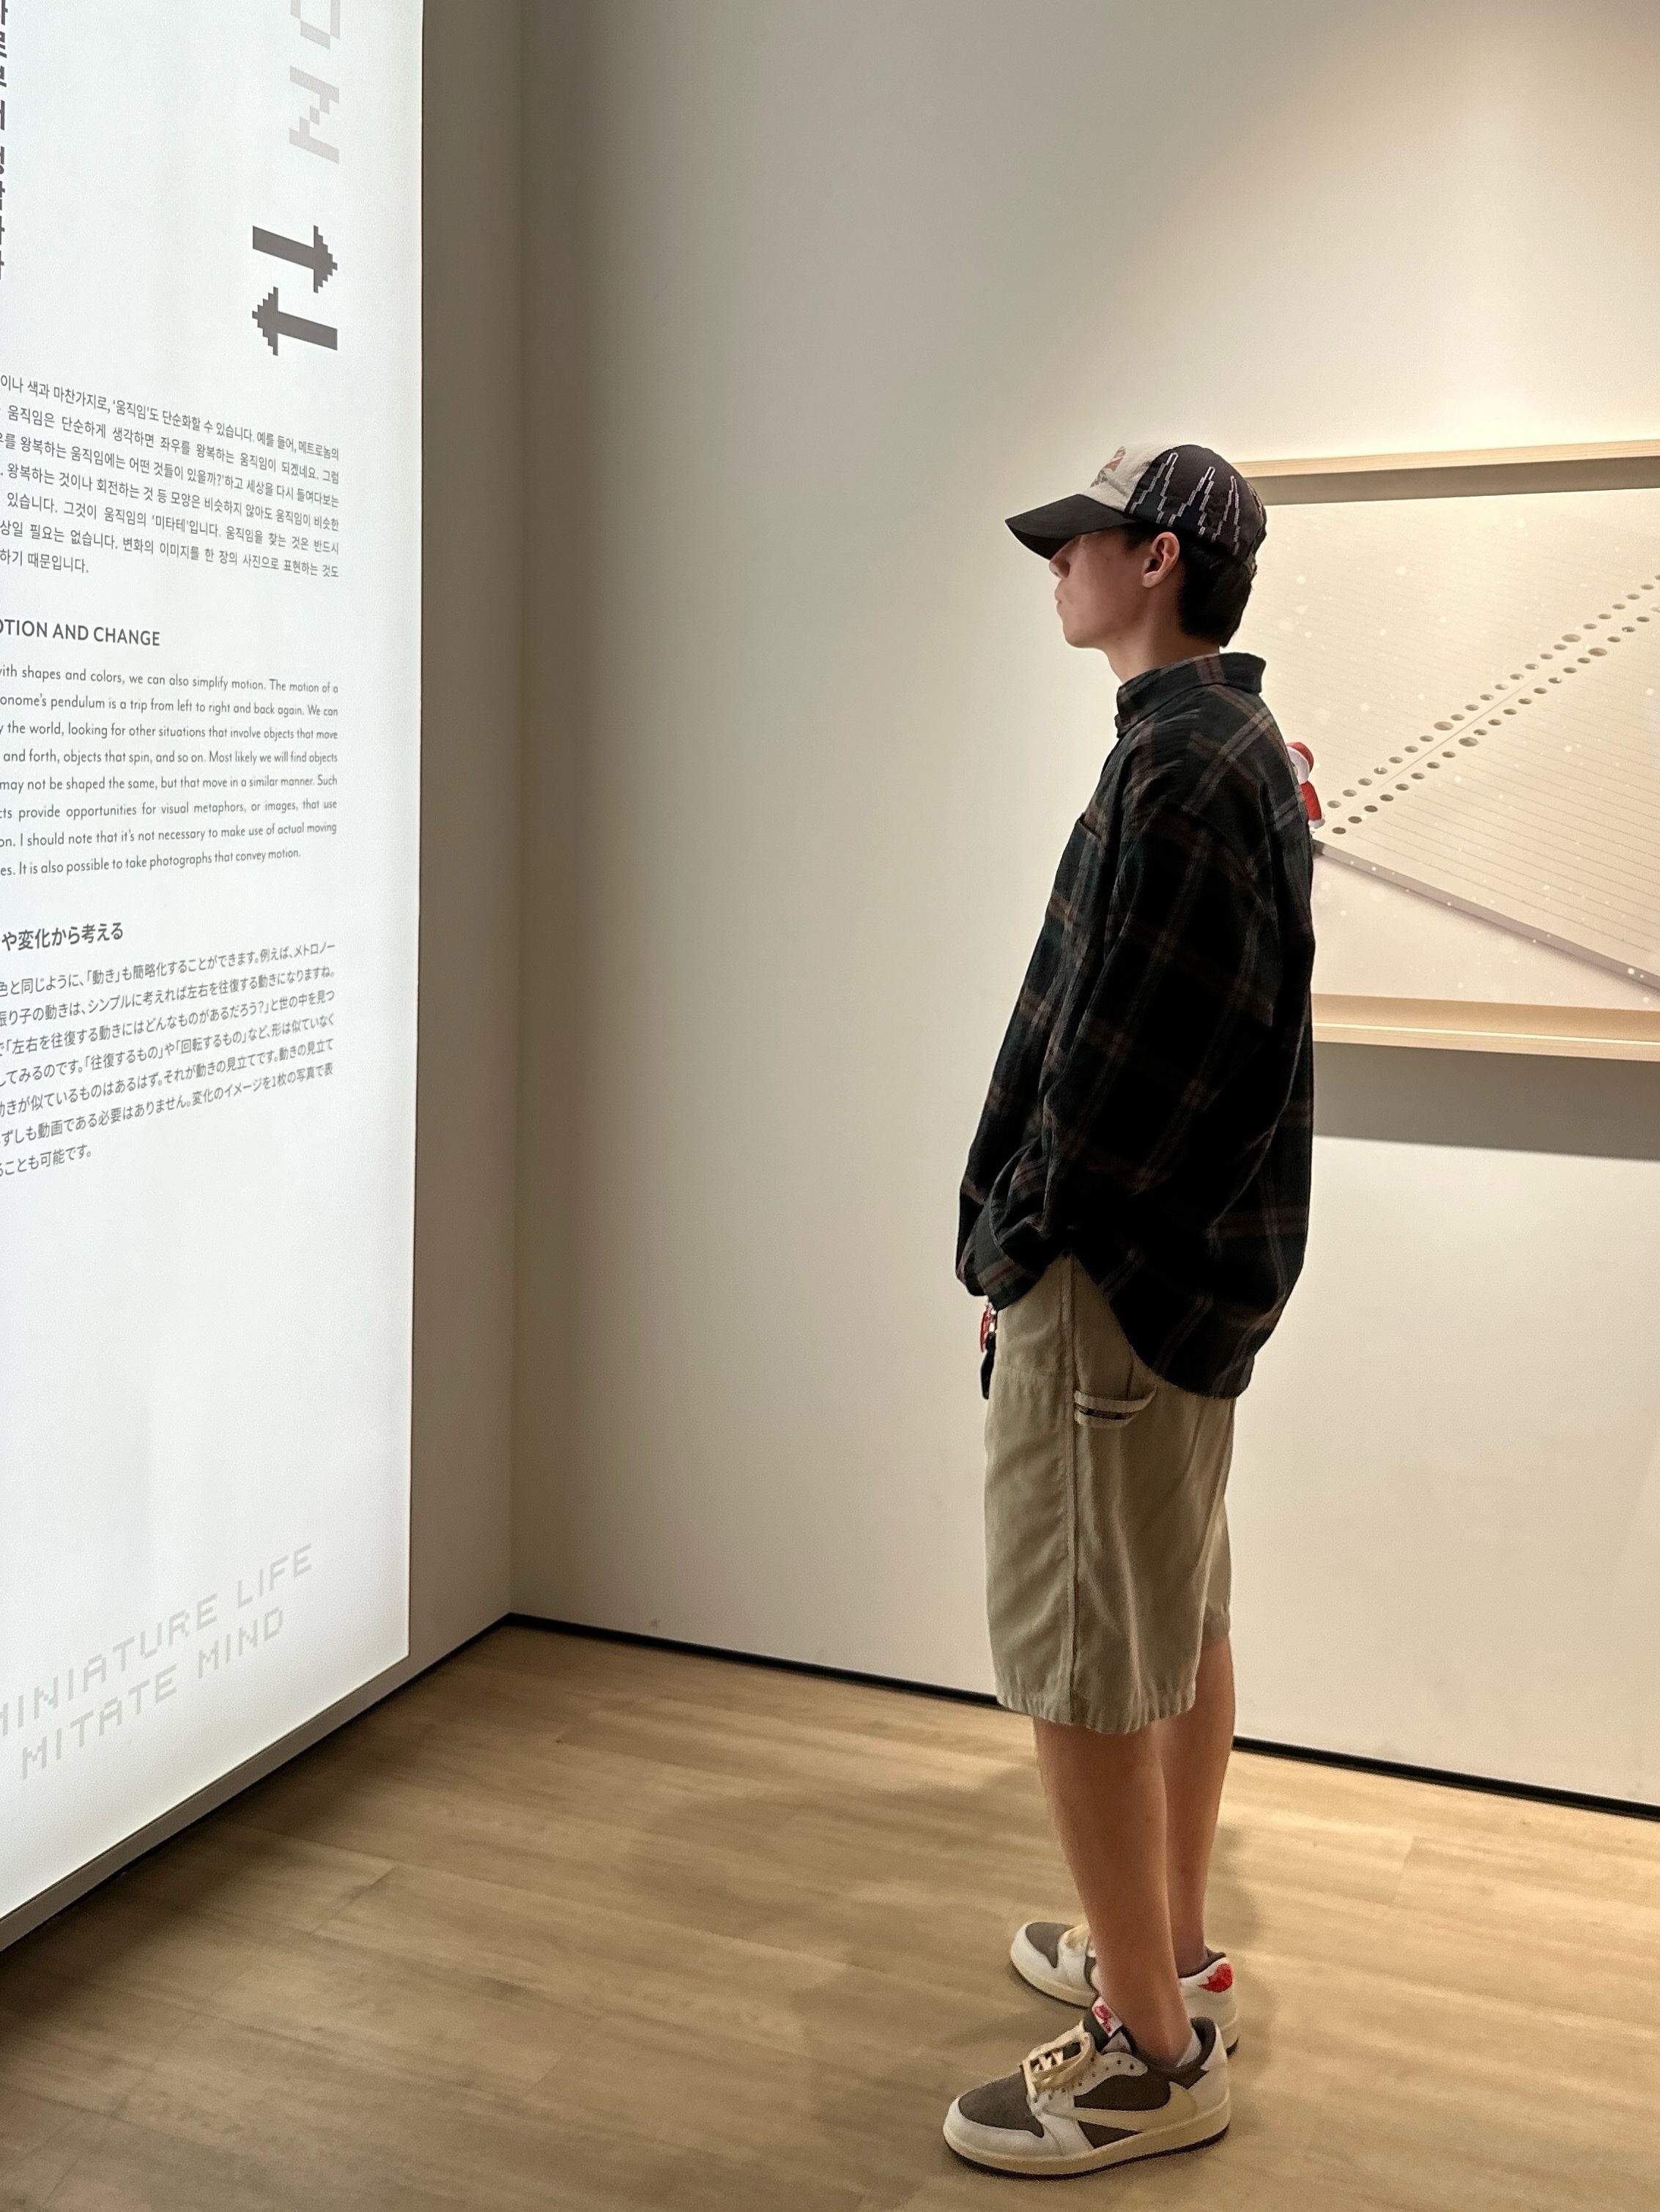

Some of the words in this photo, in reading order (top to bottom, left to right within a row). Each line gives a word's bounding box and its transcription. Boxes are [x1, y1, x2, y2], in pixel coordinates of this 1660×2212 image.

[1, 375, 23, 393] 이나
[27, 381, 50, 398] 색과
[53, 387, 110, 414] 마찬가지로,
[163, 410, 201, 431] 단순화할
[204, 420, 213, 433] 수
[216, 423, 254, 442] 있습니다.
[257, 432, 274, 447] 예를
[278, 436, 296, 453] 들어,
[299, 441, 338, 461] 메트로놈의
[8, 405, 55, 428] 움직임은
[62, 417, 105, 439] 단순하게
[113, 427, 154, 448] 생각하면
[160, 437, 190, 456] 좌우를
[196, 444, 234, 464] 왕복하는
[240, 453, 275, 472] 움직임이
[282, 461, 319, 480] 되겠네요.
[323, 470, 338, 484] 그럼
[21, 437, 67, 459] 왕복하는
[71, 446, 125, 470] 움직임에는
[130, 458, 149, 474] 어떤
[154, 462, 183, 480] 것들이
[247, 480, 273, 496] 세상을
[277, 485, 293, 500] 다시
[297, 489, 338, 508] 들여다보는
[7, 463, 54, 485] 왕복하는
[59, 472, 92, 491] 것이나
[97, 478, 139, 499] 회전하는
[144, 487, 152, 501] 것
[158, 489, 167, 503] 등
[171, 491, 200, 509] 모양은
[204, 497, 242, 516] 비슷하지
[246, 505, 273, 519] 않아도
[276, 509, 310, 527] 움직임이
[314, 516, 339, 531] 비슷한
[7, 492, 57, 513] 있습니다.
[64, 502, 96, 519] 그것이
[104, 507, 146, 527] 움직임의
[226, 526, 263, 544] 움직임을
[269, 532, 286, 547] 찾는
[292, 536, 308, 551] 것은
[314, 540, 338, 554] 반드시
[0, 520, 23, 537] 상일
[30, 524, 64, 543] 필요는
[70, 530, 118, 549] 없습니다.
[123, 538, 153, 554] 변화의
[160, 543, 199, 560] 이미지를
[219, 551, 237, 565] 장의
[242, 554, 279, 569] 사진으로
[284, 560, 318, 576] 표현하는
[322, 565, 339, 577] 것도
[0, 549, 22, 566] 하기
[28, 553, 89, 573] 때문입니다.
[53, 623, 89, 640] AND
[94, 627, 160, 646] CHANGE
[22, 664, 61, 683] shapes
[65, 668, 86, 680] and
[91, 669, 125, 685] colors,
[147, 677, 165, 685] can
[169, 674, 189, 686] also
[193, 675, 228, 691] simplify
[231, 680, 266, 689] motion.
[270, 678, 286, 691] The
[289, 683, 319, 692] motion
[51, 694, 105, 710] pendulum
[130, 699, 147, 713] trip
[151, 698, 174, 710] from
[177, 699, 192, 711] left
[209, 701, 230, 716] right
[234, 702, 251, 713] and
[254, 702, 275, 714] back
[278, 708, 304, 718] again.
[308, 705, 321, 716] We
[7, 720, 25, 733] the
[29, 721, 64, 736] world,
[69, 722, 107, 739] looking
[111, 723, 125, 735] for
[129, 724, 155, 736] other
[159, 726, 205, 737] situations
[209, 725, 227, 738] that
[231, 727, 261, 738] involve
[264, 727, 294, 741] objects
[297, 728, 314, 738] that
[4, 749, 25, 762] and
[29, 749, 59, 764] forth,
[64, 749, 101, 765] objects
[105, 749, 126, 762] that
[129, 751, 152, 765] spin,
[156, 750, 174, 762] and
[210, 751, 231, 762] Most
[235, 751, 257, 765] likely
[274, 751, 288, 762] will
[291, 751, 306, 762] find
[309, 751, 337, 765] objects
[0, 782, 24, 794] may
[28, 779, 45, 790] not
[50, 776, 62, 790] be
[67, 776, 105, 793] shaped
[109, 776, 125, 789] the
[128, 781, 158, 790] same,
[161, 776, 177, 788] but
[180, 776, 199, 787] that
[203, 779, 227, 787] move
[249, 775, 278, 787] similar
[317, 774, 337, 785] Such
[19, 804, 60, 822] provide
[67, 804, 136, 820] opportunities
[142, 802, 156, 814] for
[161, 801, 188, 814] visual
[194, 801, 246, 815] metaphors,
[251, 803, 260, 812] or
[265, 801, 298, 813] images,
[303, 798, 319, 809] that
[27, 831, 64, 846] should
[69, 834, 92, 844] note
[96, 831, 117, 843] that
[122, 829, 134, 842] it's
[138, 831, 155, 841] not
[158, 831, 205, 842] necessary
[221, 825, 245, 836] make
[278, 822, 304, 834] actual
[307, 822, 336, 834] moving
[41, 860, 63, 873] also
[67, 857, 109, 875] possible
[126, 855, 147, 868] take
[150, 851, 212, 870] photographs
[215, 850, 233, 862] that
[236, 853, 266, 862] convey
[268, 847, 302, 858] motion.
[1, 922, 123, 951] や変化から考える
[237, 1543, 312, 1610] LIFE
[22, 1663, 177, 1781] MITATE
[198, 1606, 284, 1680] MIND
